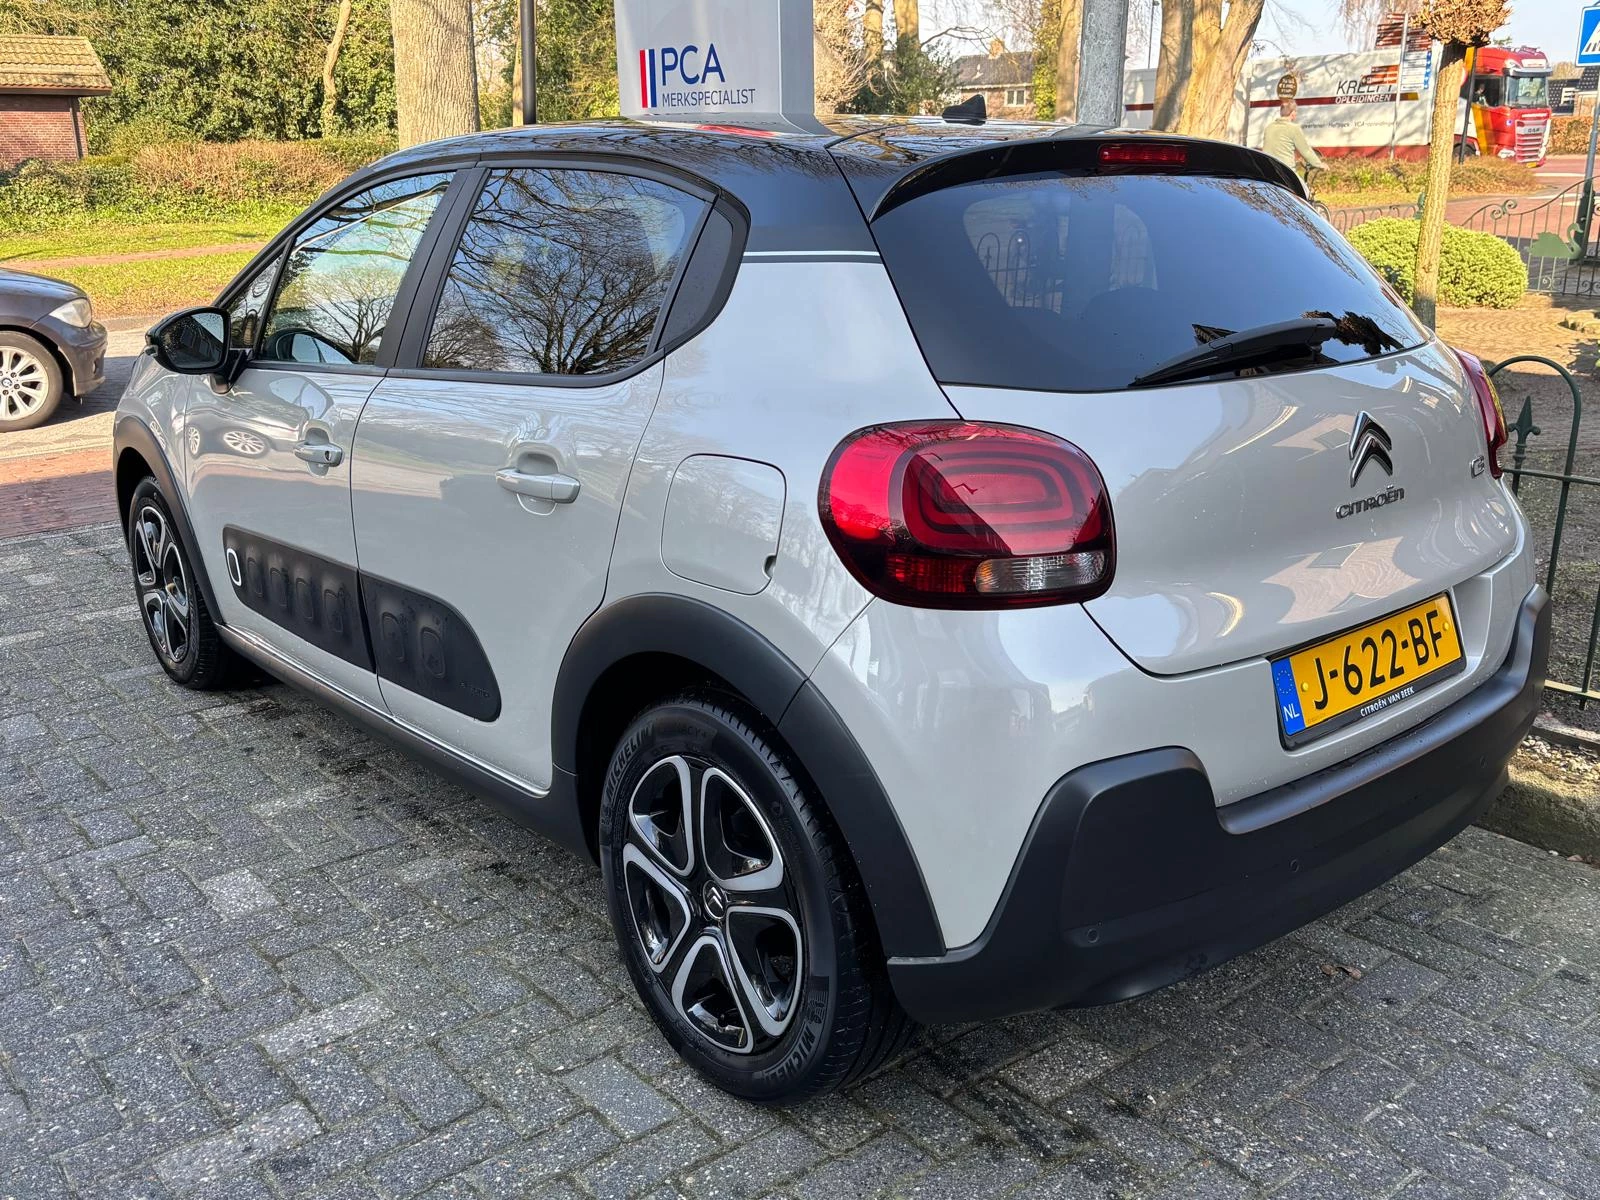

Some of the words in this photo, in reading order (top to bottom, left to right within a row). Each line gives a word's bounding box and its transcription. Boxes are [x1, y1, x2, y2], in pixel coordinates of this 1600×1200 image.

[661, 43, 726, 86] PCA
[662, 88, 756, 107] MERKSPECIALIST
[1335, 94, 1392, 104] OPLEIDINGEN
[1313, 609, 1443, 710] J-622-BF
[1387, 692, 1400, 704] VAN
[1400, 686, 1415, 699] BEEK
[1283, 703, 1300, 722] NL
[606, 722, 654, 798] MICHELIN
